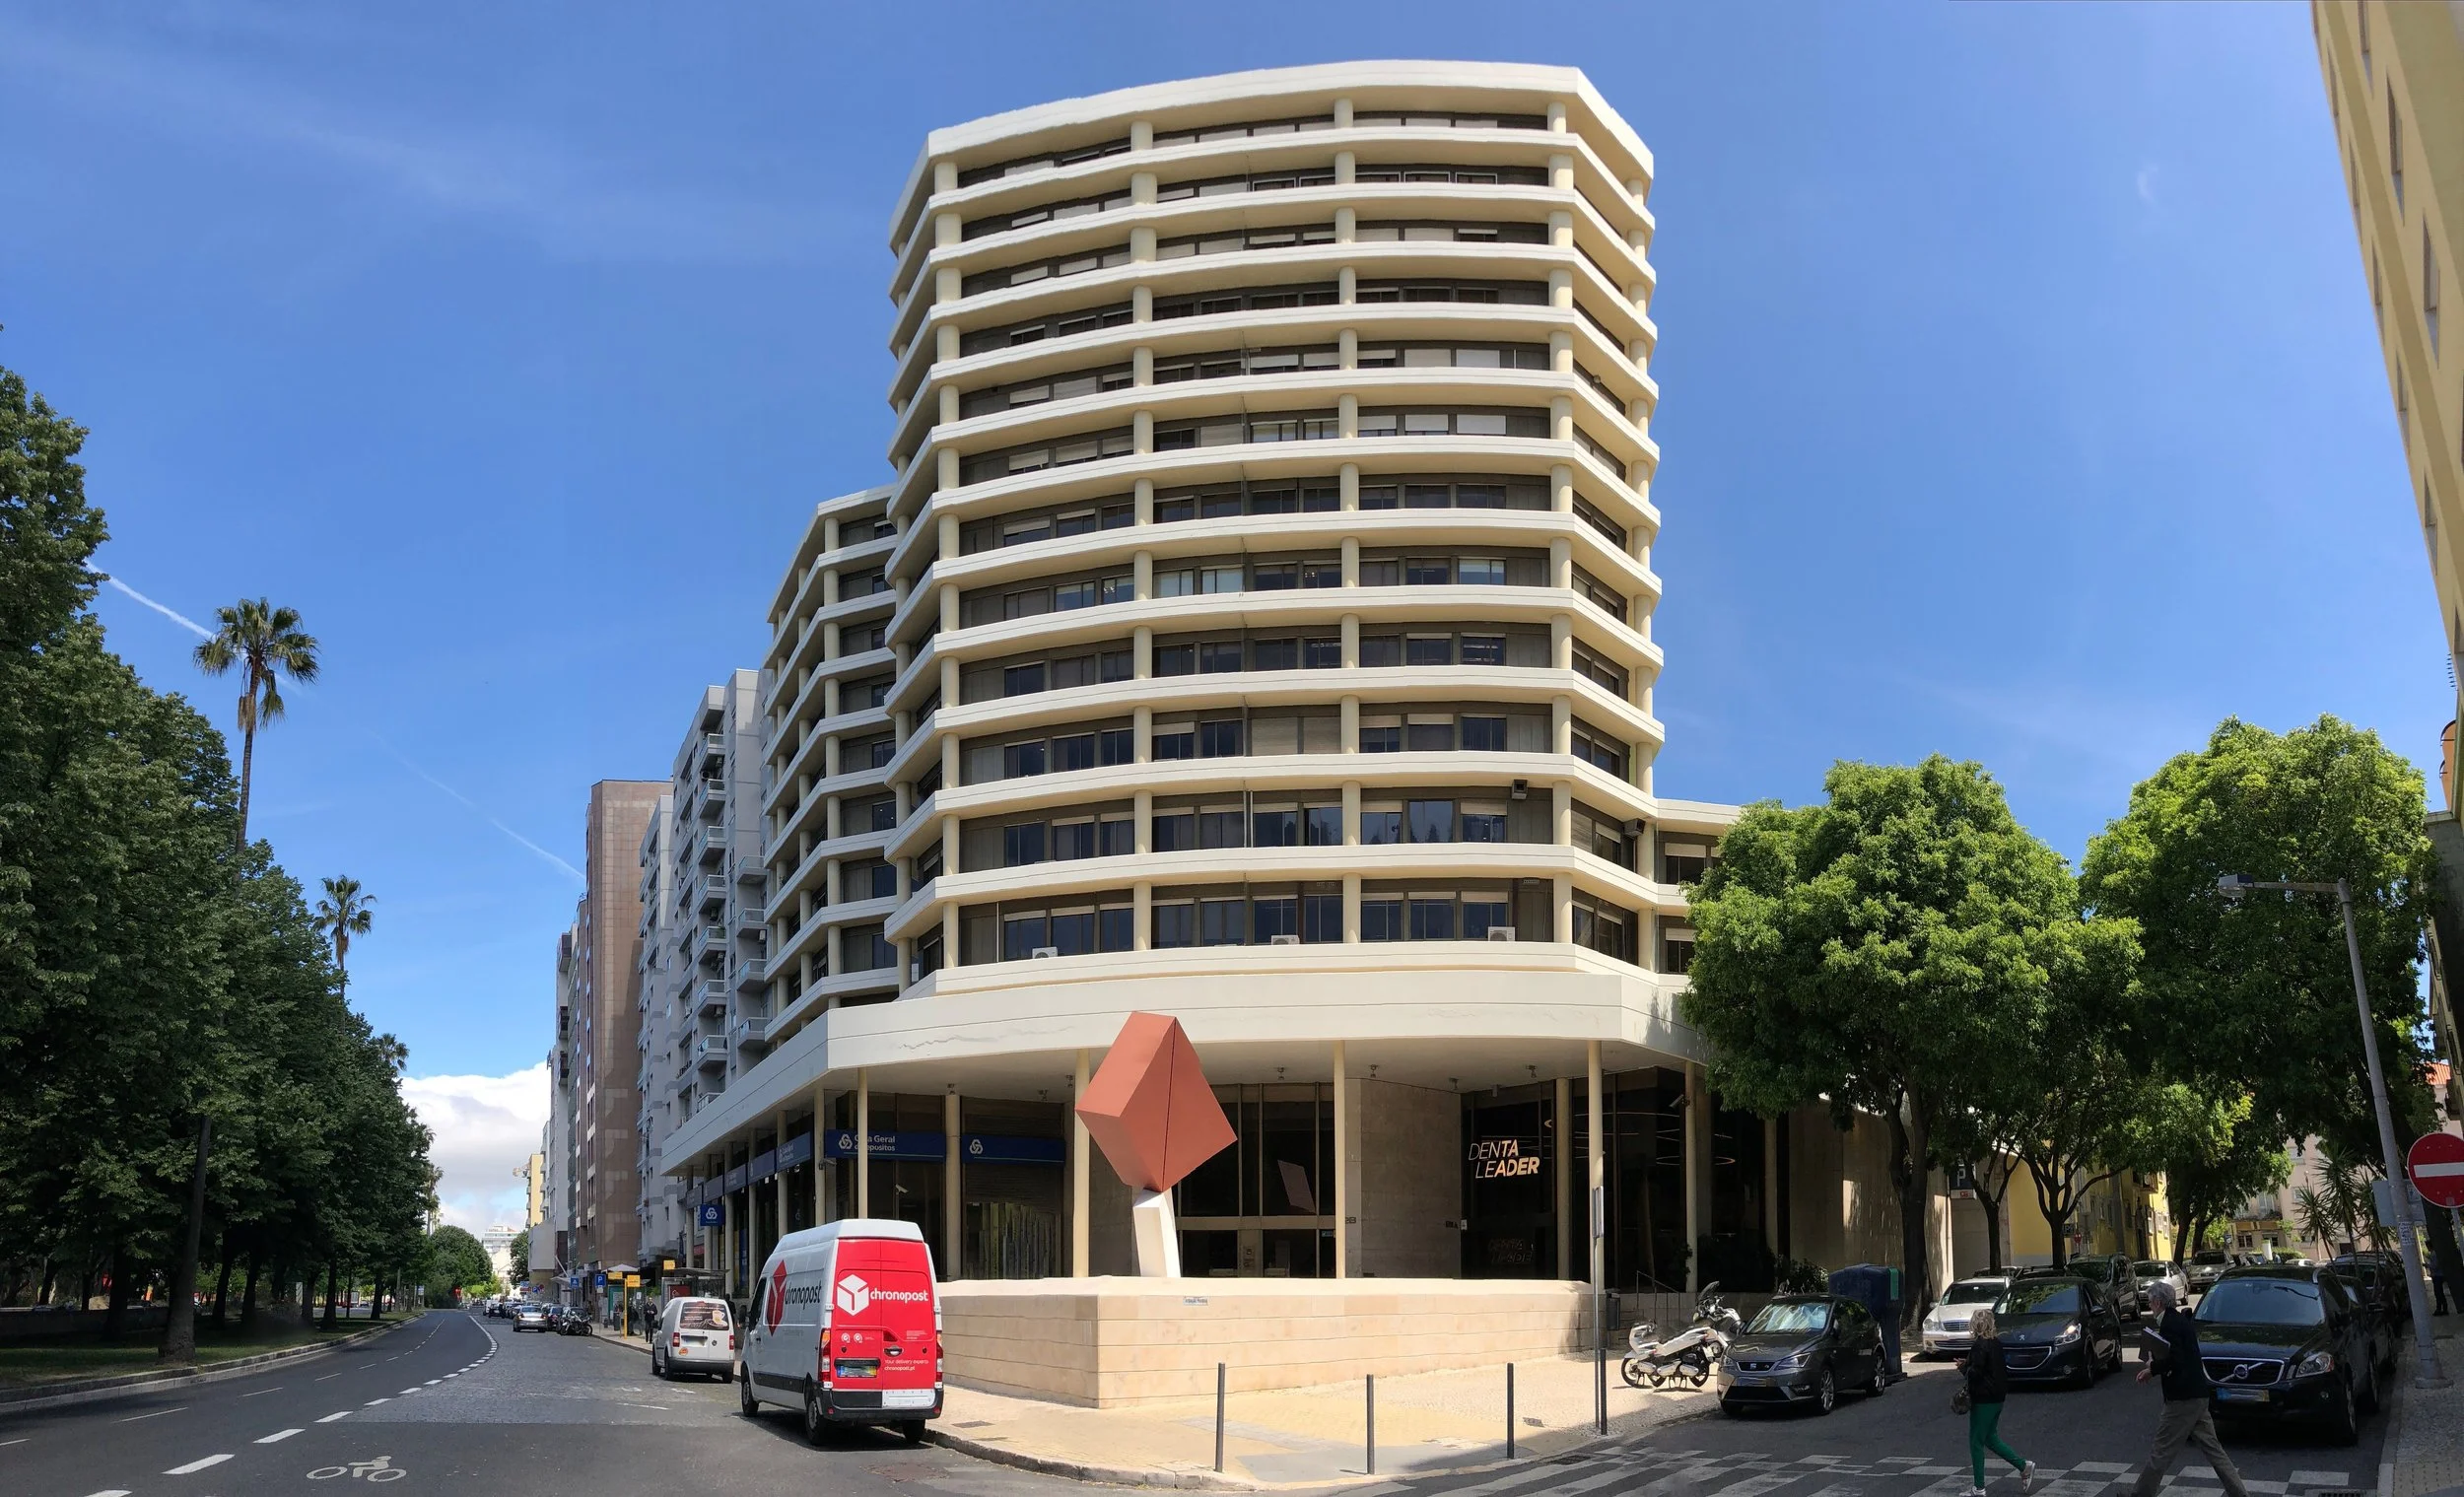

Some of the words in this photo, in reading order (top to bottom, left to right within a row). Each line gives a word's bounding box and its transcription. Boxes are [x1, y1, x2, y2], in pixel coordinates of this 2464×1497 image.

[873, 1134, 896, 1143] Geral
[1468, 1139, 1519, 1161] DENTA
[1475, 1157, 1540, 1179] LEADER
[785, 1281, 822, 1311] chronopost
[869, 1287, 929, 1304] chronopost
